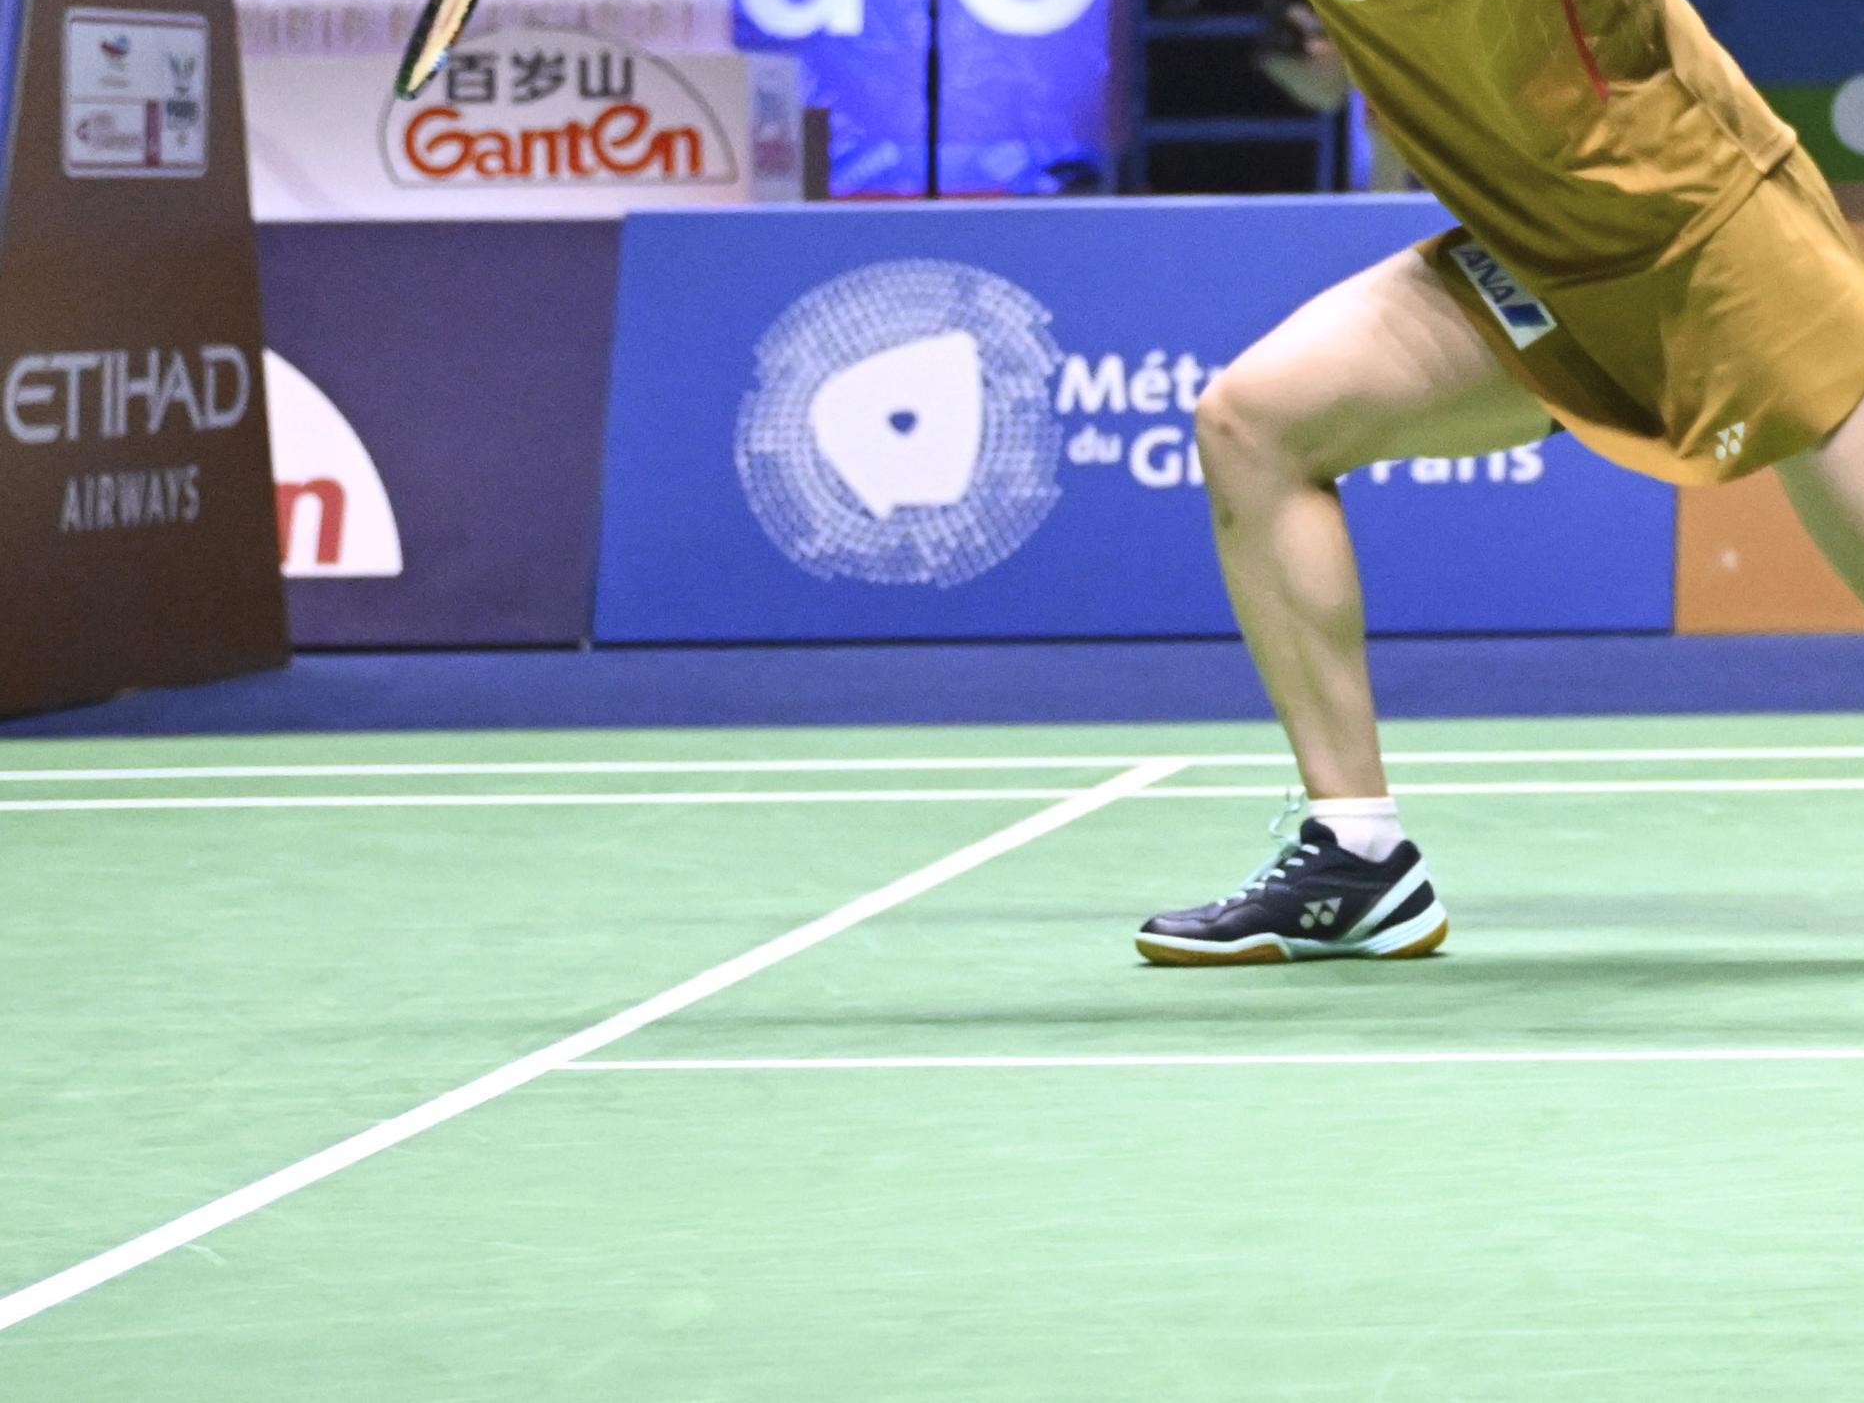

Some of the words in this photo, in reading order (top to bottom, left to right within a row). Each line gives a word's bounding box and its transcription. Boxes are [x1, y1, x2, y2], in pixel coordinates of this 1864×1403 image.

[446, 50, 634, 103] 百岁山
[4, 344, 251, 444] ETIHAD
[60, 464, 201, 533] AIRWAYS
